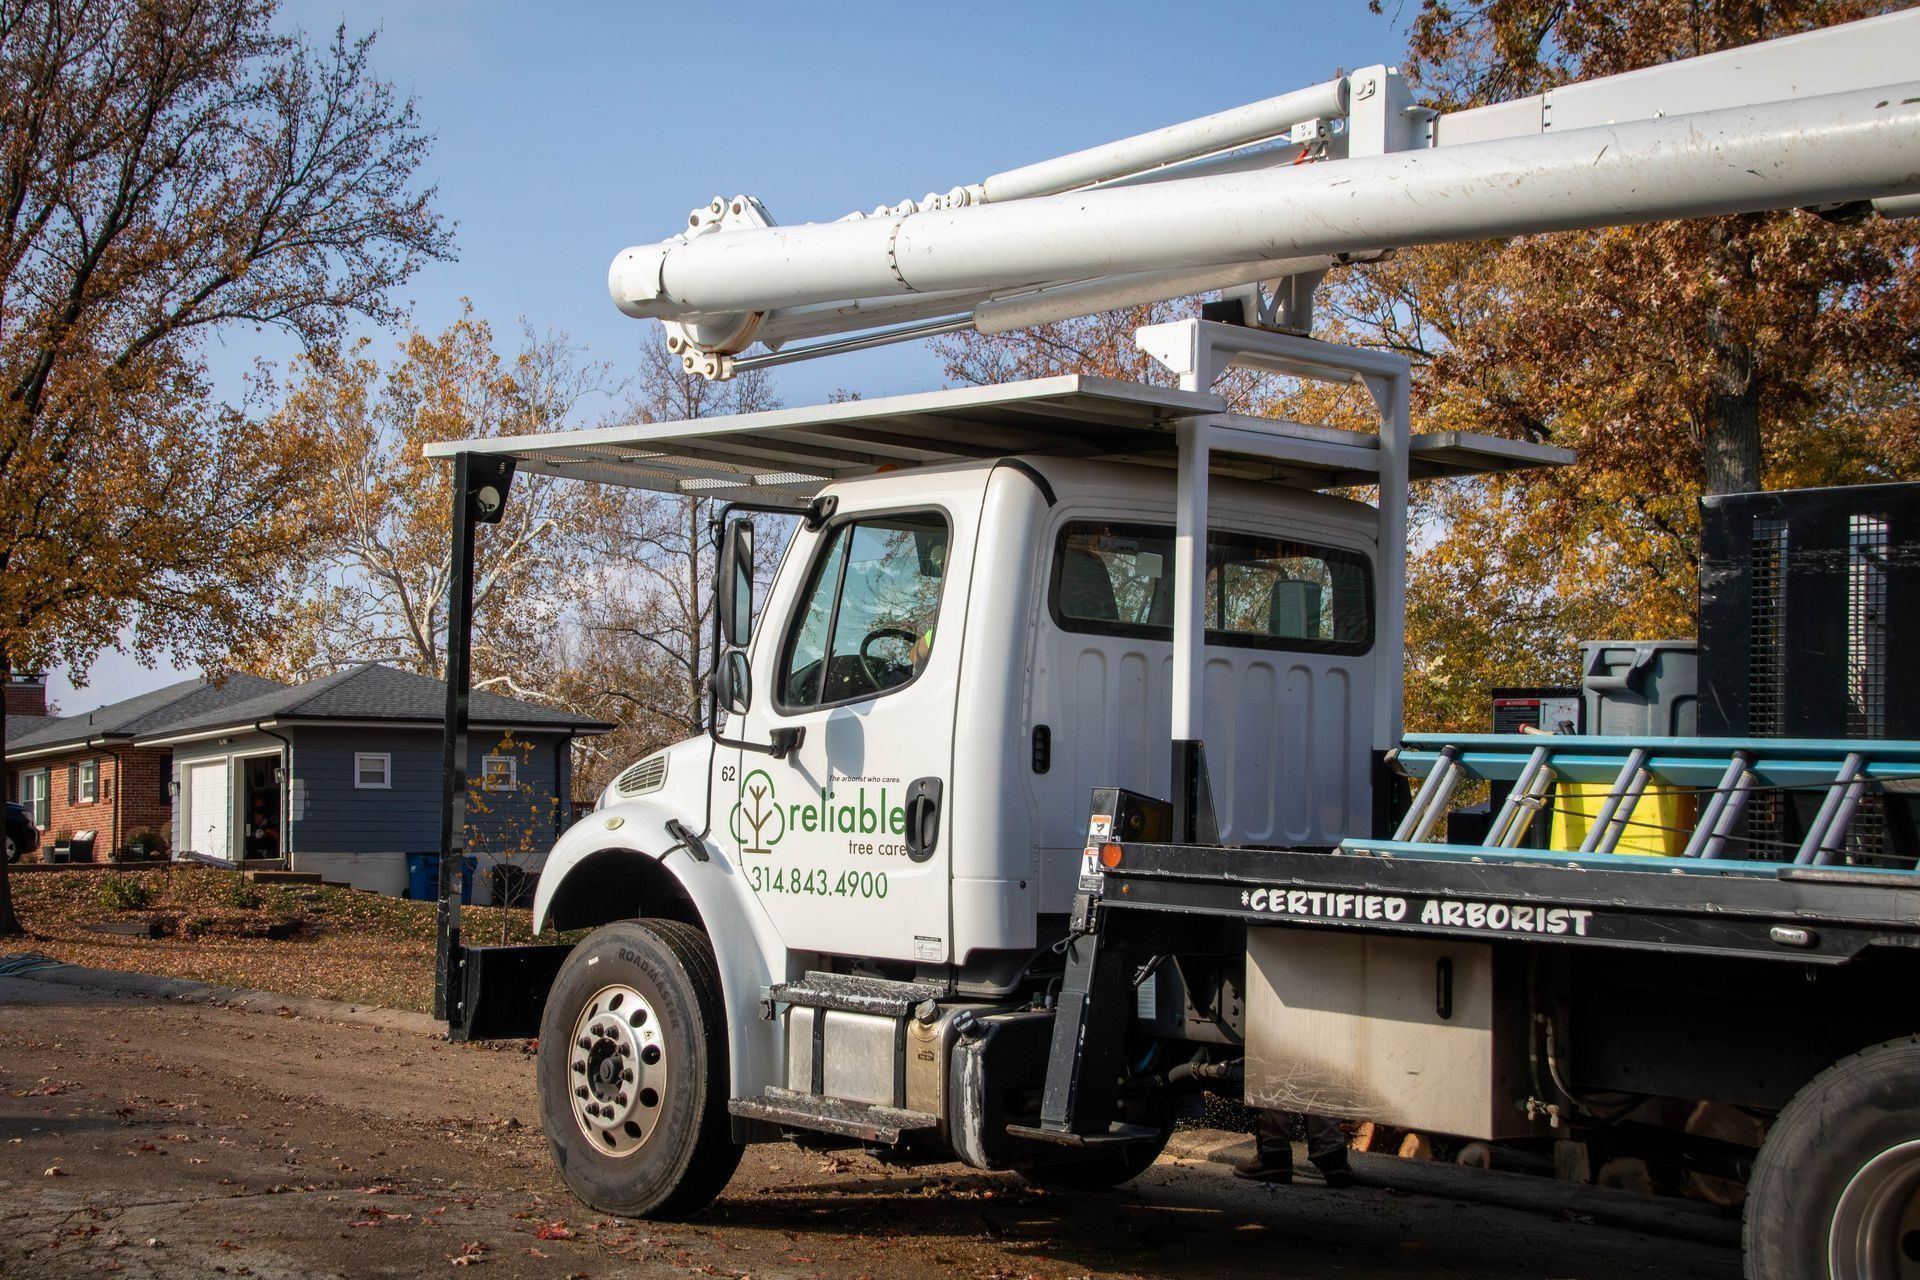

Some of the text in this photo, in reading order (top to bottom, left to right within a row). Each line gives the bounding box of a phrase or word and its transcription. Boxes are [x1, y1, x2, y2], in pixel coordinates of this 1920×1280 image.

[721, 765, 736, 782] 62
[842, 775, 866, 783] arborist
[867, 775, 881, 783] who
[789, 786, 906, 835] reliable
[848, 839, 907, 856] tree care
[751, 865, 888, 899] 314.843.4900
[1420, 899, 1594, 936] ARBORIST
